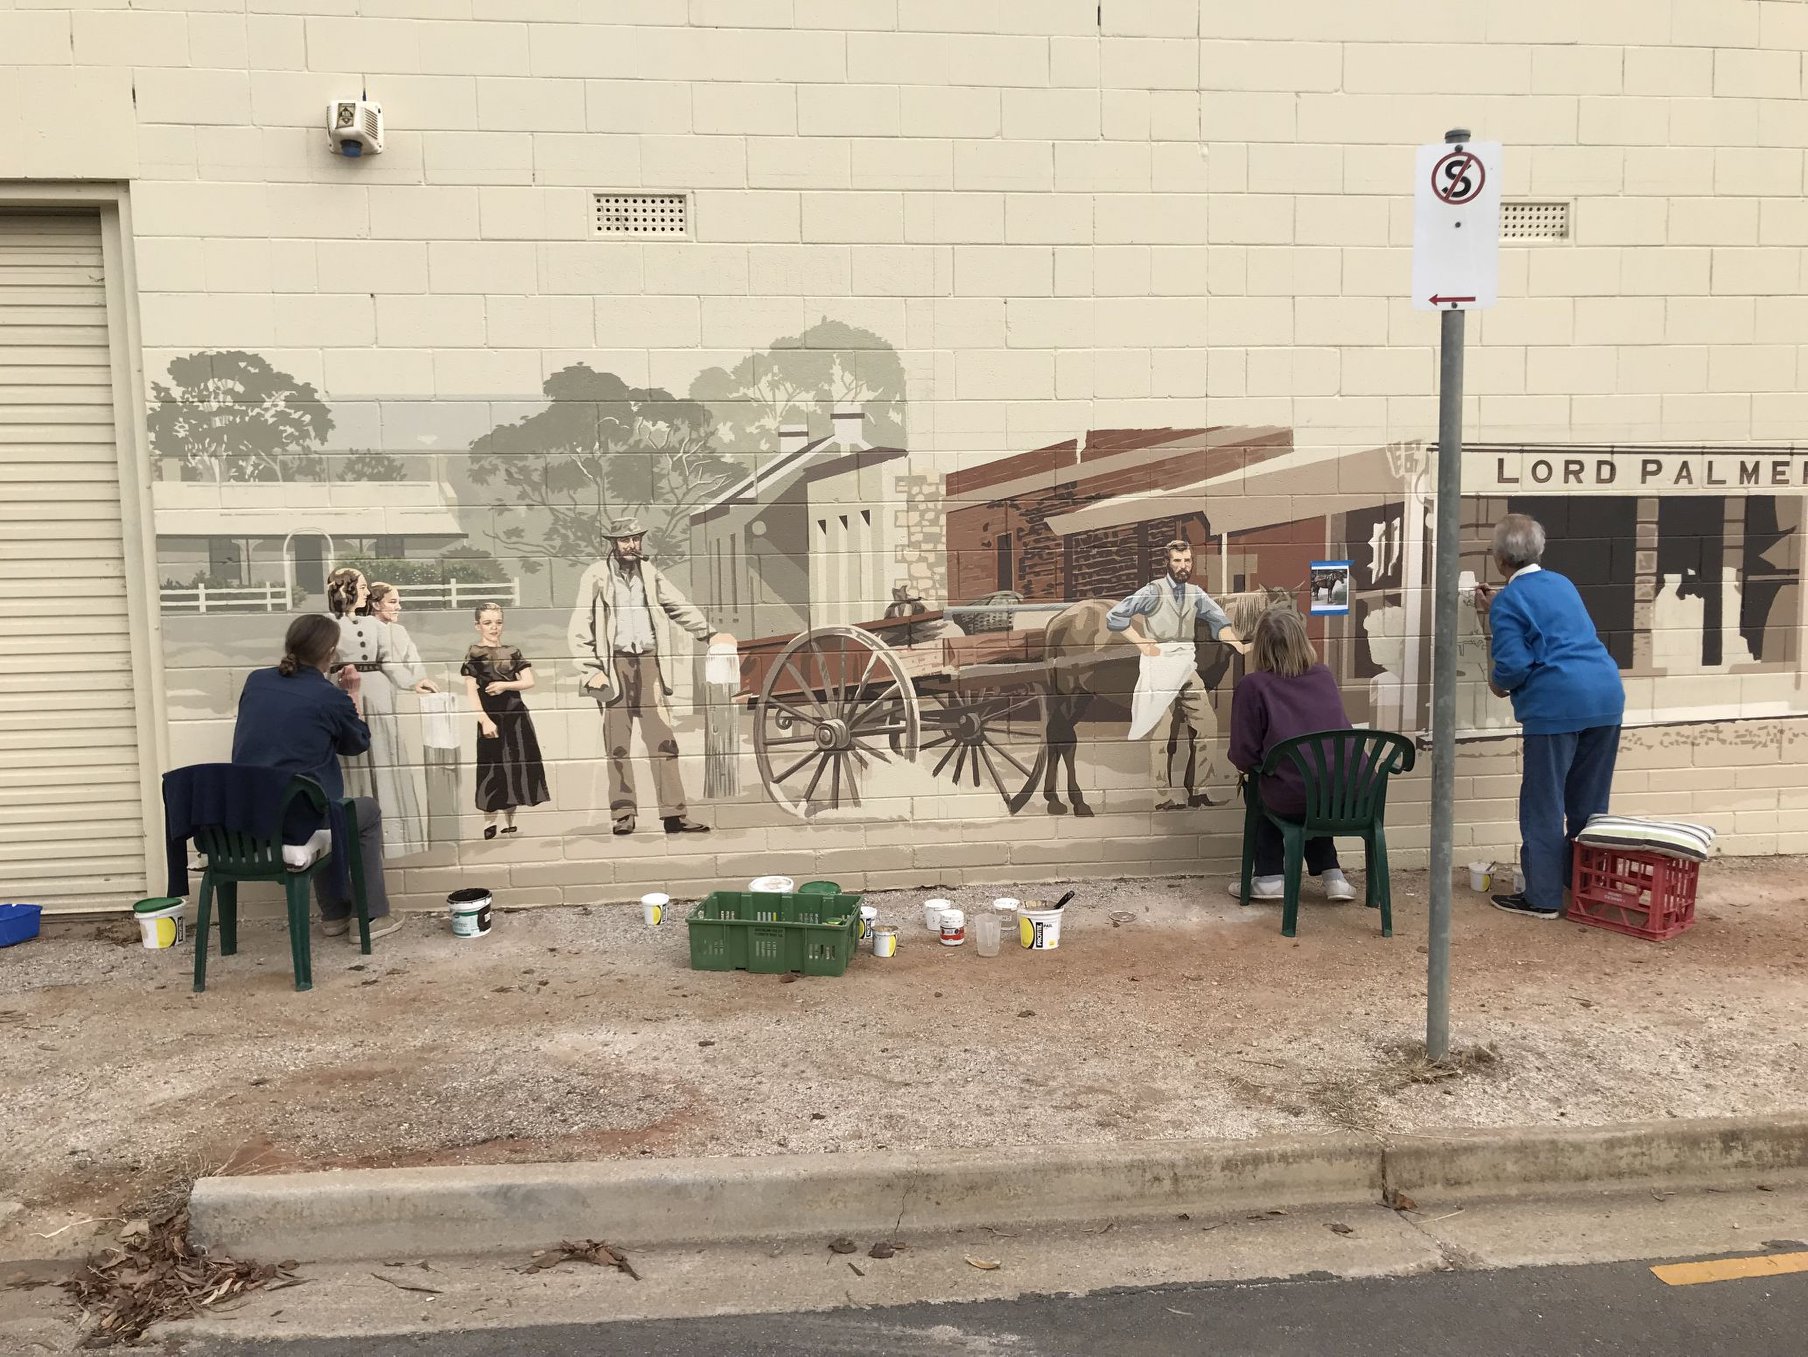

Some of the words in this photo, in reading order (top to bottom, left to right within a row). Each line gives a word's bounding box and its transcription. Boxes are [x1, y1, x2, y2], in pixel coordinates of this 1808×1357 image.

[1441, 159, 1472, 198] S
[1497, 457, 1616, 484] LORD
[1640, 458, 1808, 485] PALME
